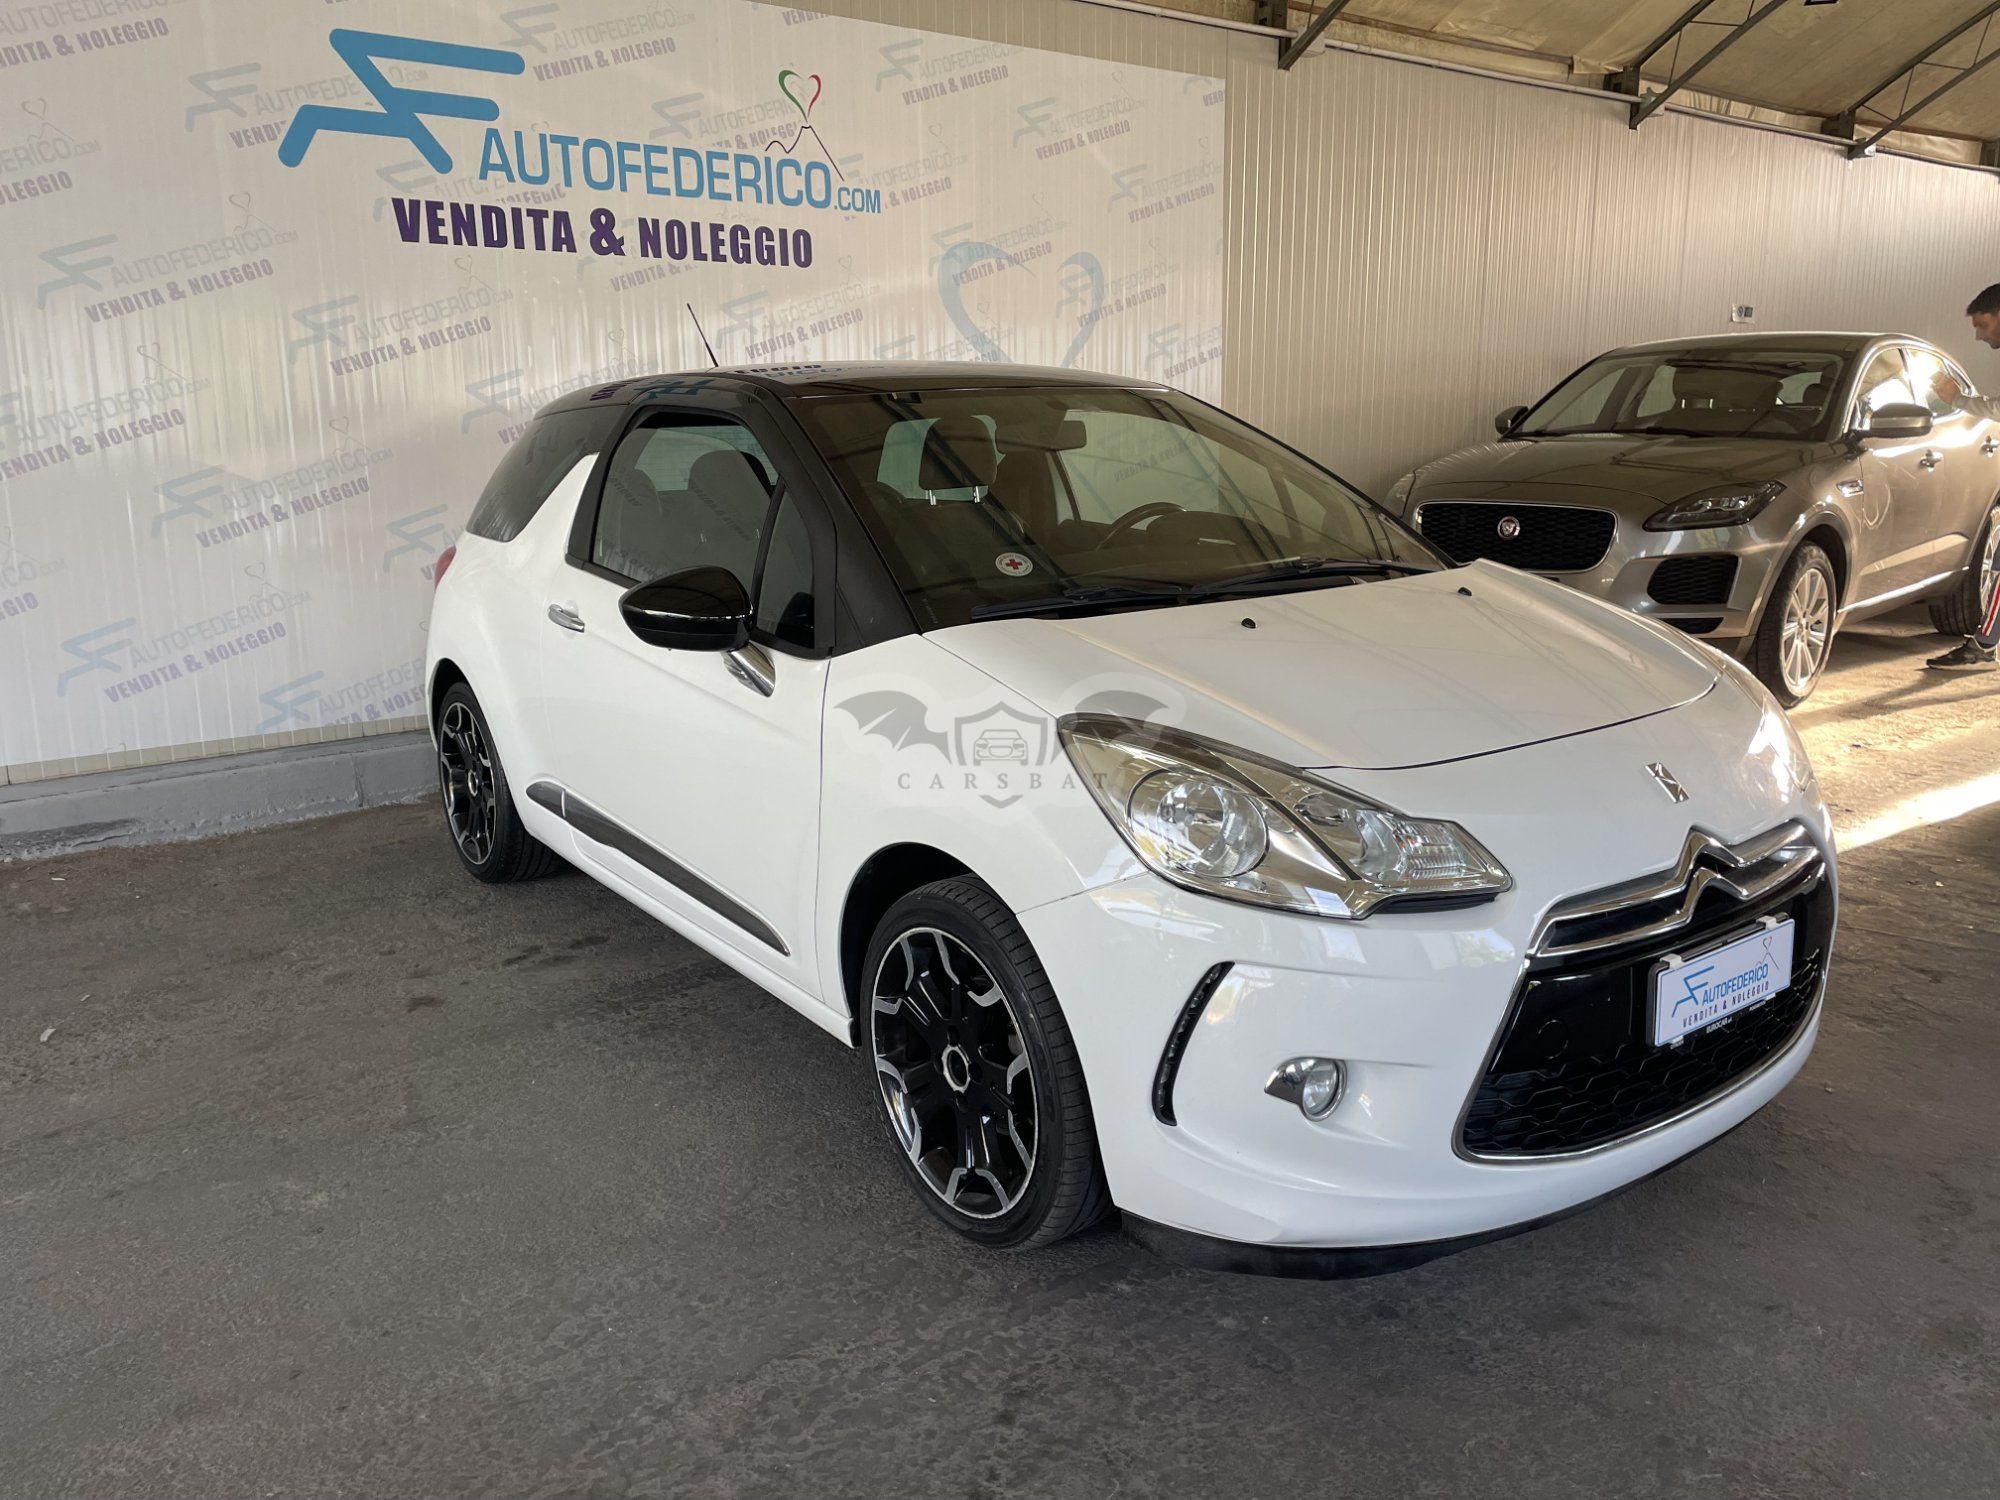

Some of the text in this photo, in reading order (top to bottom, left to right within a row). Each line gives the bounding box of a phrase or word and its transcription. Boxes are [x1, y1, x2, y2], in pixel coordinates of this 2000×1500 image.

[52, 34, 75, 56] &
[76, 17, 170, 52] NOLEGGIO
[532, 36, 677, 82] VENDITA & NOLEGGIO
[902, 80, 948, 106] VENDITA
[960, 64, 1009, 91] NOLEGGIO
[1035, 137, 1076, 161] VENDITA
[1087, 119, 1131, 144] NOLEGGIO
[901, 175, 953, 204] NOLEGGIO
[391, 197, 813, 268] VENDITA & NOLEGGIO
[84, 258, 275, 323] VENDITA & NOLEGGIO
[329, 315, 492, 377] VENDITA & NOLEGGIO
[744, 331, 796, 360] VENDITA
[809, 307, 864, 338] NOLEGGIO
[72, 435, 94, 457] &
[94, 408, 187, 449] NOLEGGIO
[196, 475, 371, 549] VENDITA & NOLEGGIO
[104, 621, 288, 703] VENDITA & NOLEGGIO
[1682, 1003, 1719, 1029] VENDITA
[1731, 981, 1770, 1006] NOLEGGIO
[1701, 963, 1769, 1007] AUTOFEDERICO
